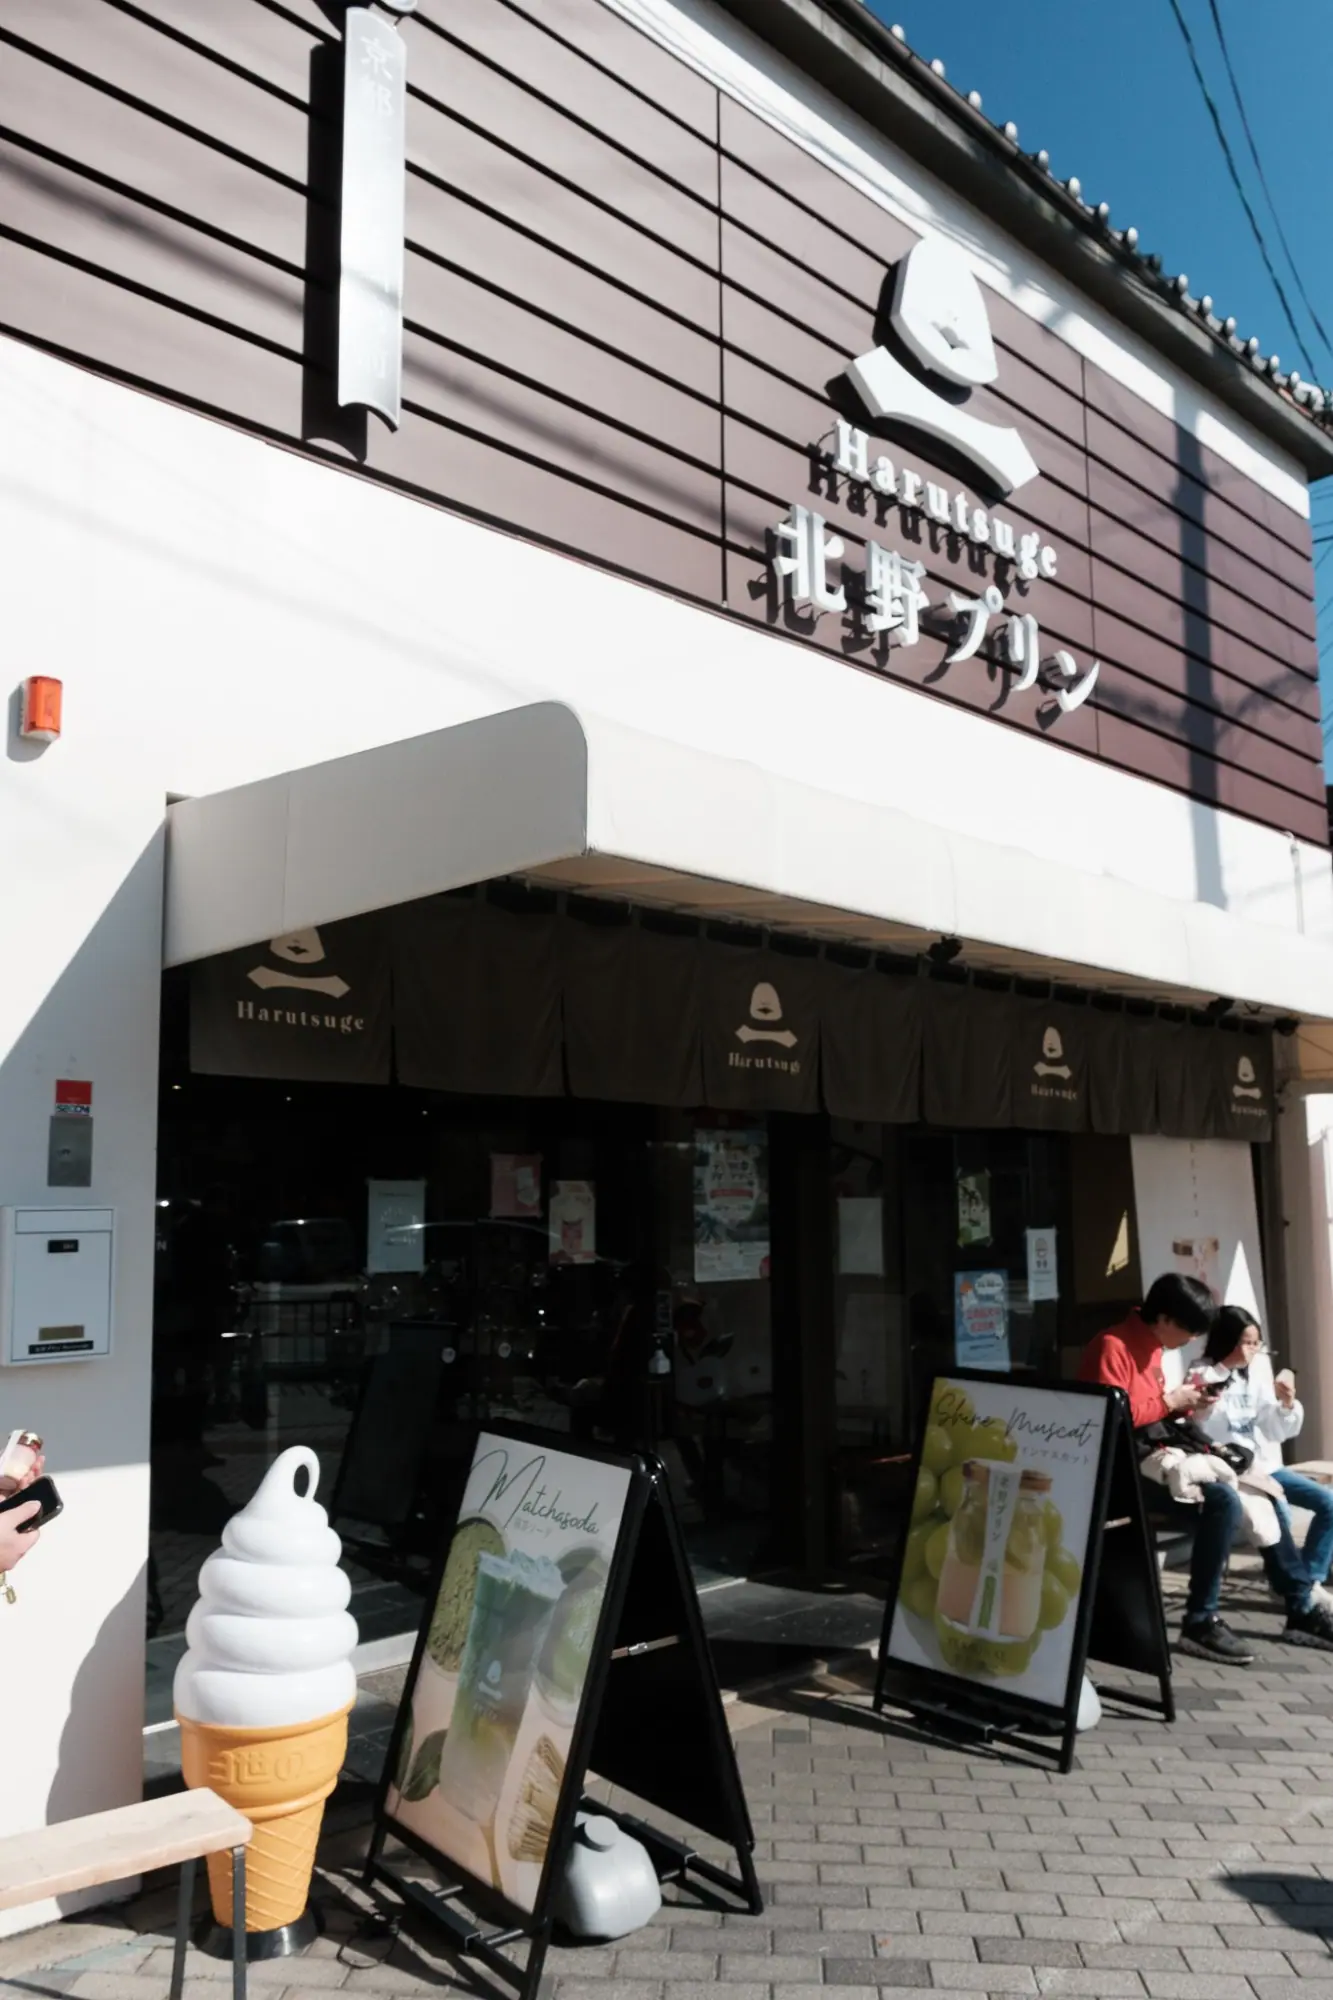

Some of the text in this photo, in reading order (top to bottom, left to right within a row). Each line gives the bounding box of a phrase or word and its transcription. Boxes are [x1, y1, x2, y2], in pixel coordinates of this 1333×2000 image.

[833, 418, 1058, 580] Harutsuge
[773, 503, 1101, 713] 北野プリン
[236, 999, 366, 1036] Harutsuge
[1004, 1406, 1101, 1448] Muscat
[470, 1448, 600, 1536] Matchasoda
